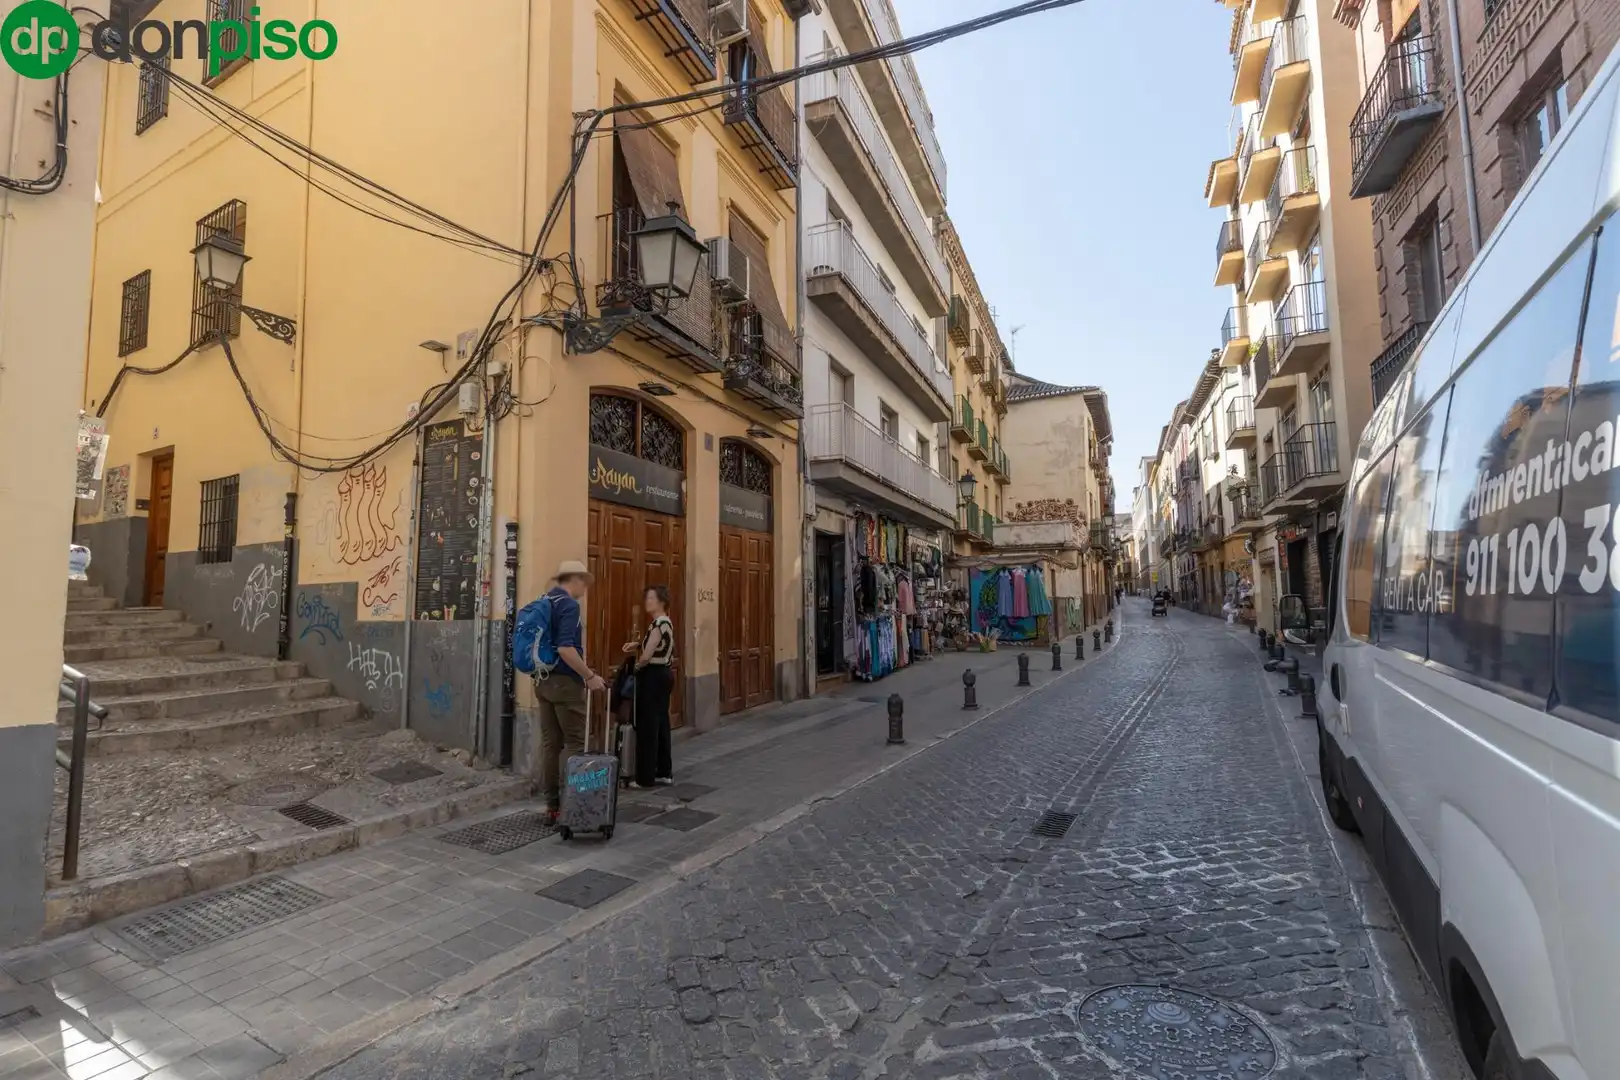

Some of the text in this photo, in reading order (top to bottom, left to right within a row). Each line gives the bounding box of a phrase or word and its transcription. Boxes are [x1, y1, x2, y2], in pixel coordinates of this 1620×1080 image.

[588, 455, 643, 495] Rayan
[1465, 533, 1499, 596] 911
[1506, 516, 1567, 595] 100
[1383, 569, 1444, 614] RENT A CAR
